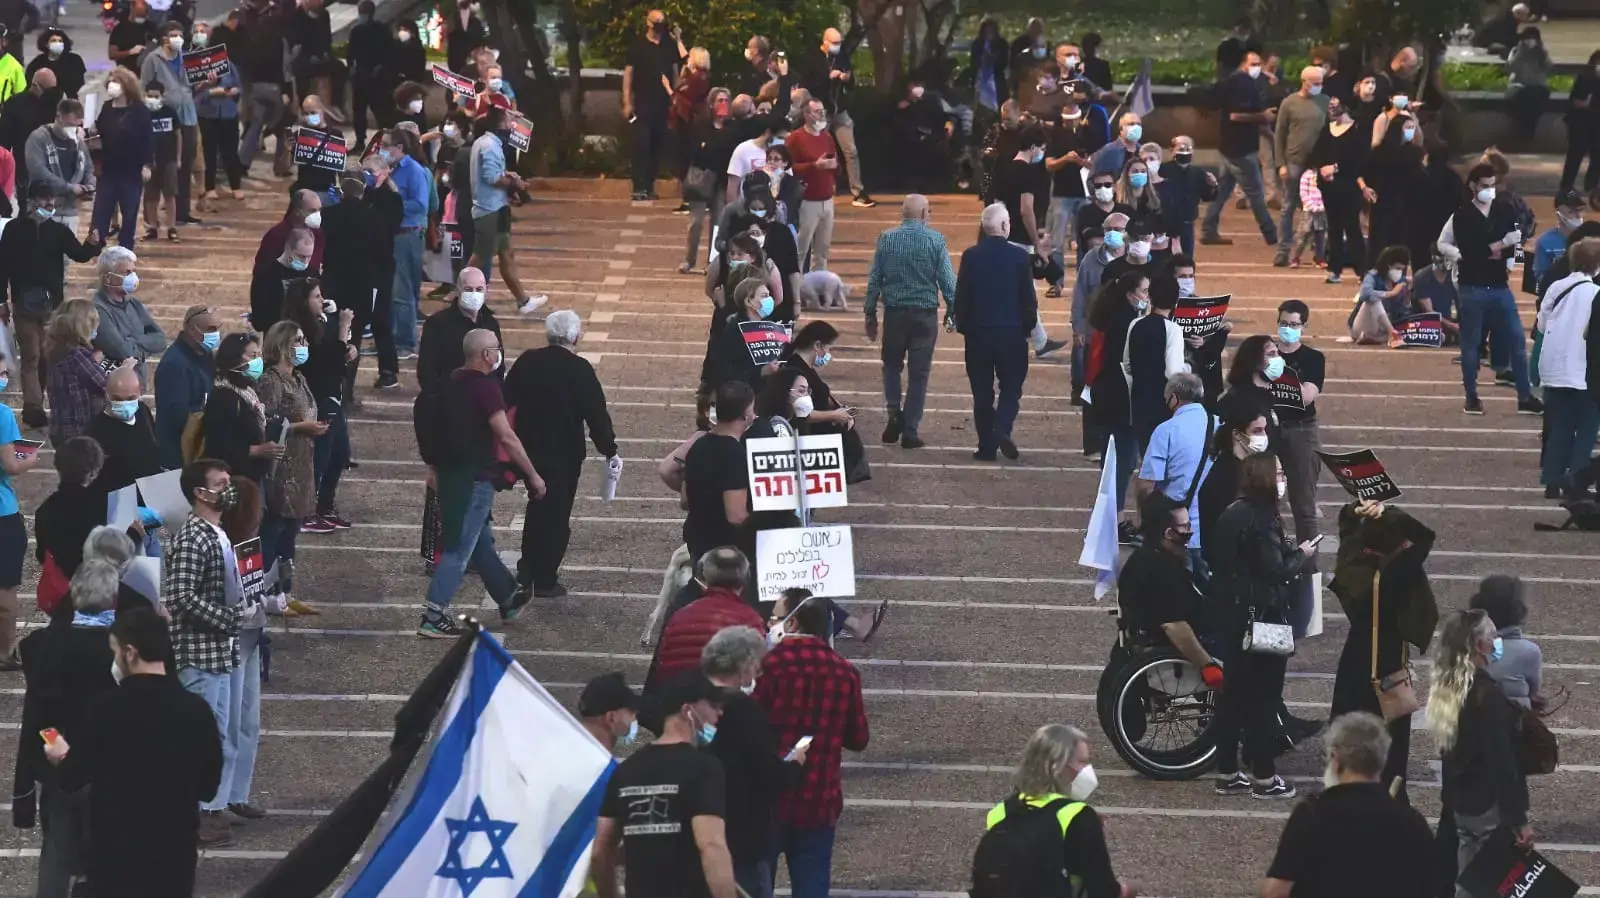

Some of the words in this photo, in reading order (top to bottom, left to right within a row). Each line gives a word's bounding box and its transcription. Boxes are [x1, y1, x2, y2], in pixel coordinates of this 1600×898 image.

[297, 151, 343, 165] לדמוקטיה
[1198, 308, 1210, 317] לא
[1182, 321, 1221, 334] לדמוקרט
[765, 332, 776, 340] לא
[752, 348, 783, 358] קרטיה
[754, 472, 843, 497] הבתה
[1356, 474, 1385, 487] יסתמו
[1358, 482, 1391, 498] לדמו
[776, 547, 822, 565] בפלילים
[812, 560, 830, 580] לא
